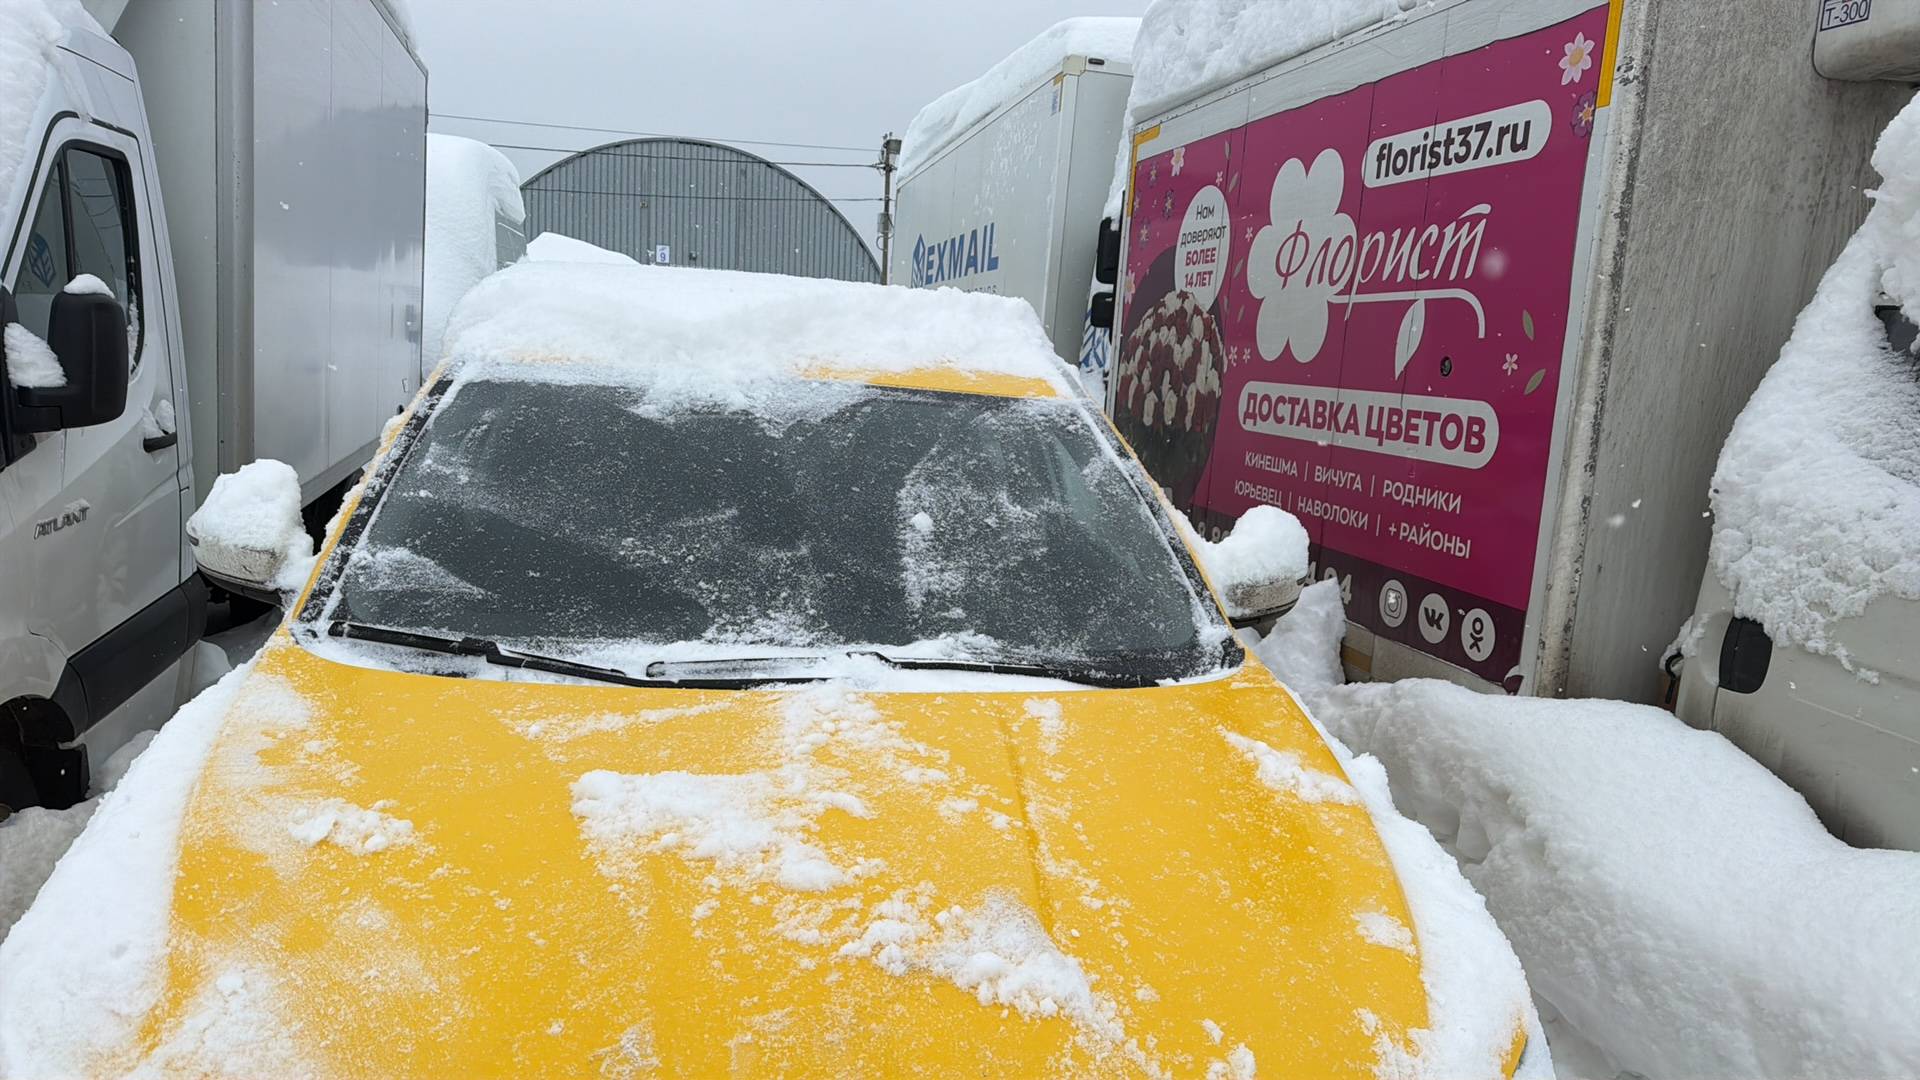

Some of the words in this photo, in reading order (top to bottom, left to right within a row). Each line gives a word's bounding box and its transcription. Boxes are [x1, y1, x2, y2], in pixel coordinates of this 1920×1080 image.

[1375, 120, 1532, 180] florist37.ru
[1195, 204, 1216, 221] Нам
[925, 222, 999, 286] EXMAIL
[1184, 273, 1194, 289] 14
[1194, 270, 1213, 288] ЛЕТ
[1185, 247, 1217, 267] БОЛЕЕ
[1275, 204, 1492, 321] Флорист
[1243, 392, 1360, 436] ДОСТАВКА
[1364, 405, 1487, 454] ЦВЕТОВ
[1234, 480, 1282, 508] ЮРЬЕВЕЦ
[1297, 496, 1368, 530] НАВОЛОКИ
[1244, 450, 1298, 477] КИНЕШМА
[1314, 465, 1363, 492] ВИЧУГА
[1382, 480, 1462, 514] РОДНИКИ
